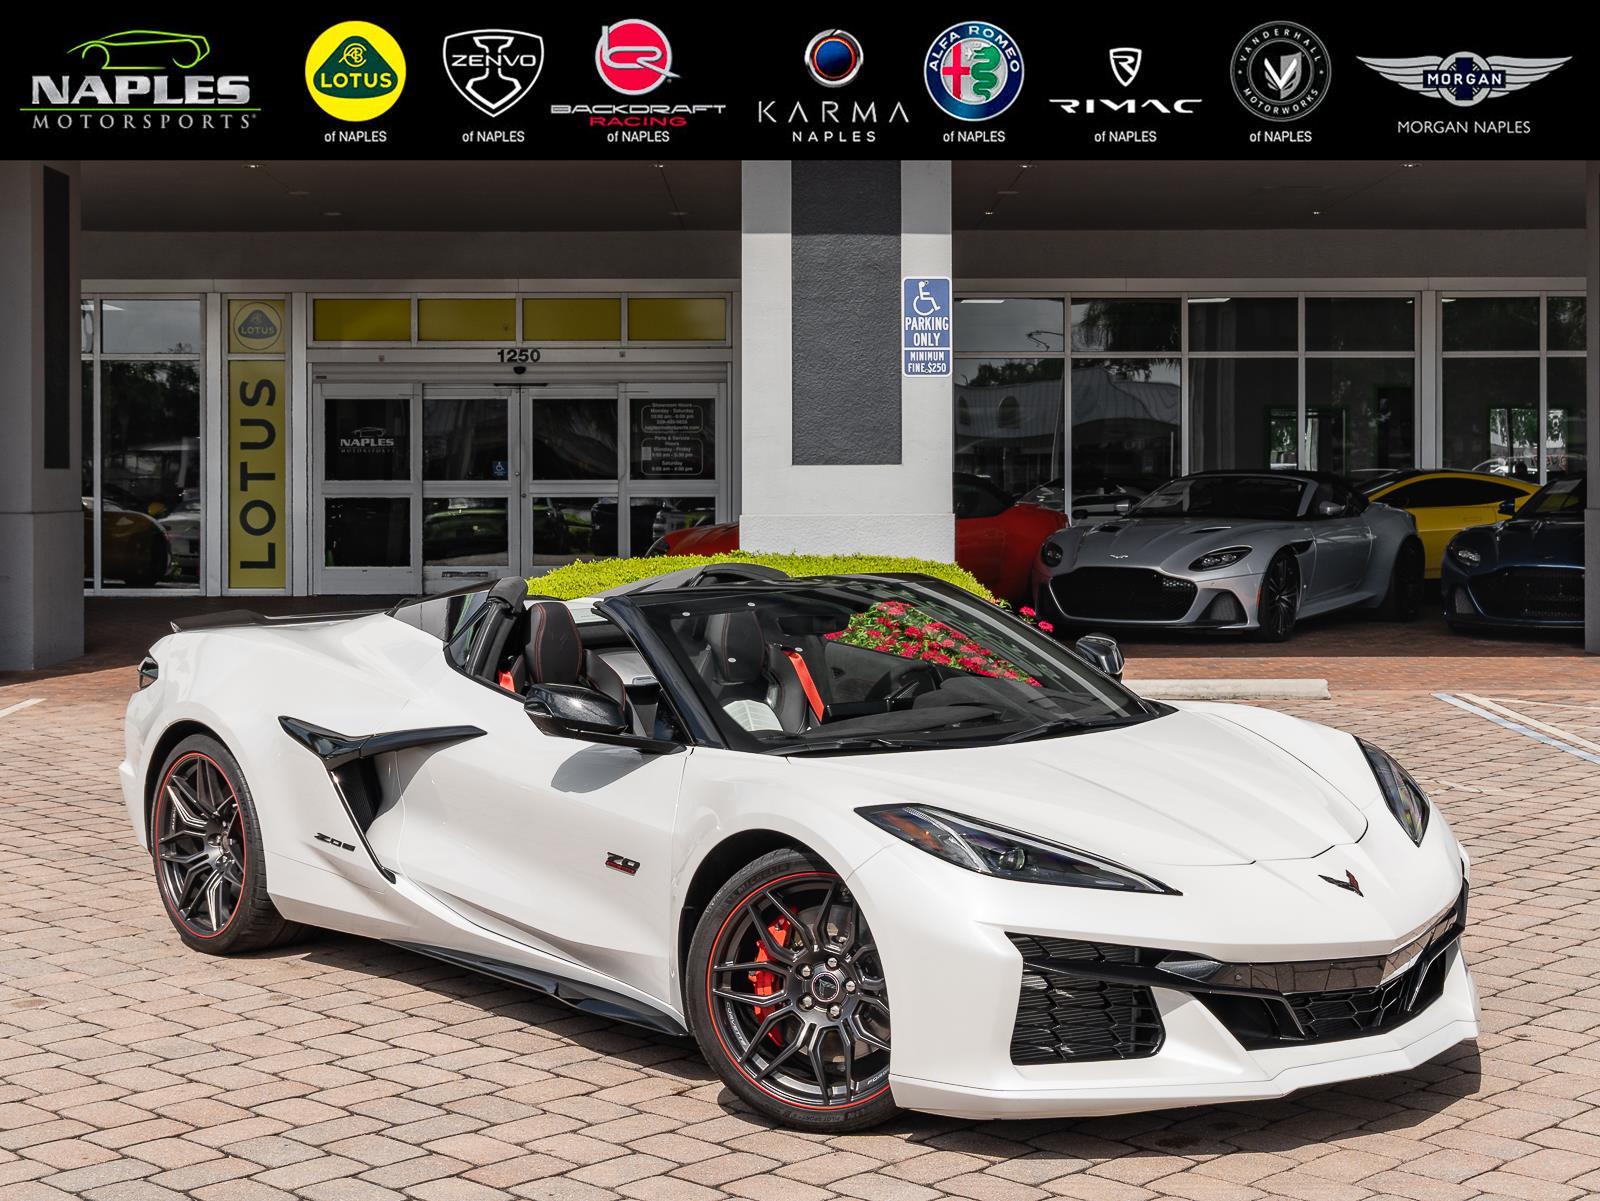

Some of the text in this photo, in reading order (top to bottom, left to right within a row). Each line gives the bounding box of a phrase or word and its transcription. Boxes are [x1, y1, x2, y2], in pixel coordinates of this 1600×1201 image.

[905, 316, 949, 331] PARKING
[241, 326, 274, 335] LOTUS
[913, 332, 941, 347] ONLY
[497, 348, 541, 363] 1250
[909, 351, 945, 361] MINIMUM
[908, 362, 947, 373] FINE $250
[340, 438, 395, 447] NAPLES
[239, 378, 277, 570] LOTUS
